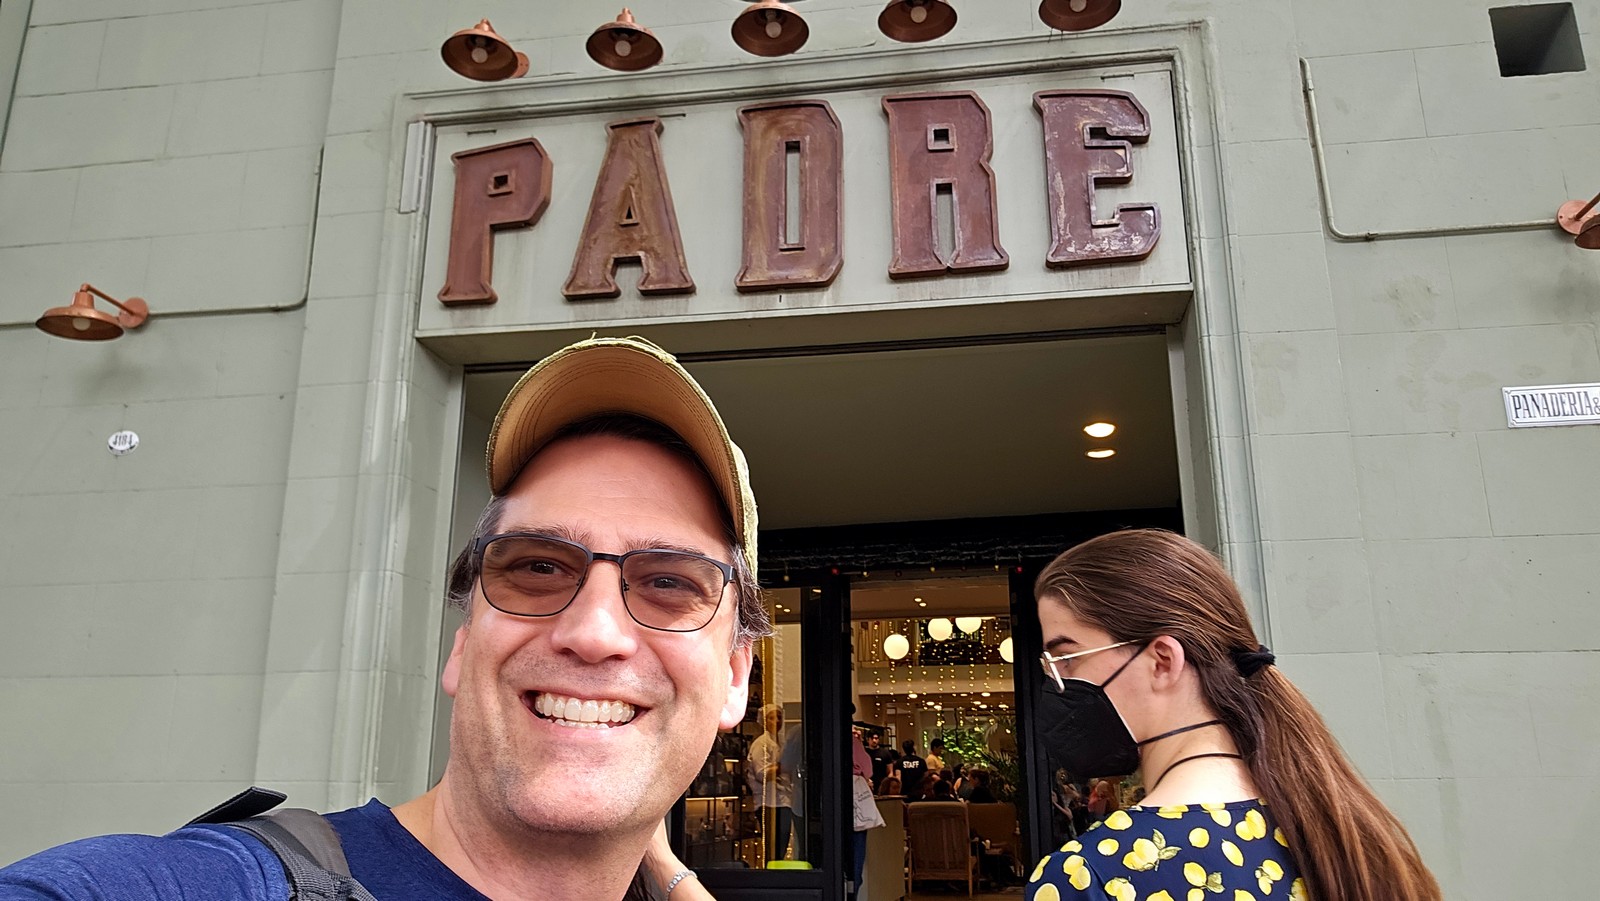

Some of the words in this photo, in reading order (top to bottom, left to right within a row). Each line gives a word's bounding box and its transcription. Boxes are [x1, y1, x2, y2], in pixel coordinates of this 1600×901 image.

[438, 90, 1162, 306] PADRE
[112, 434, 133, 447] 4184
[902, 760, 920, 769] STAFF
